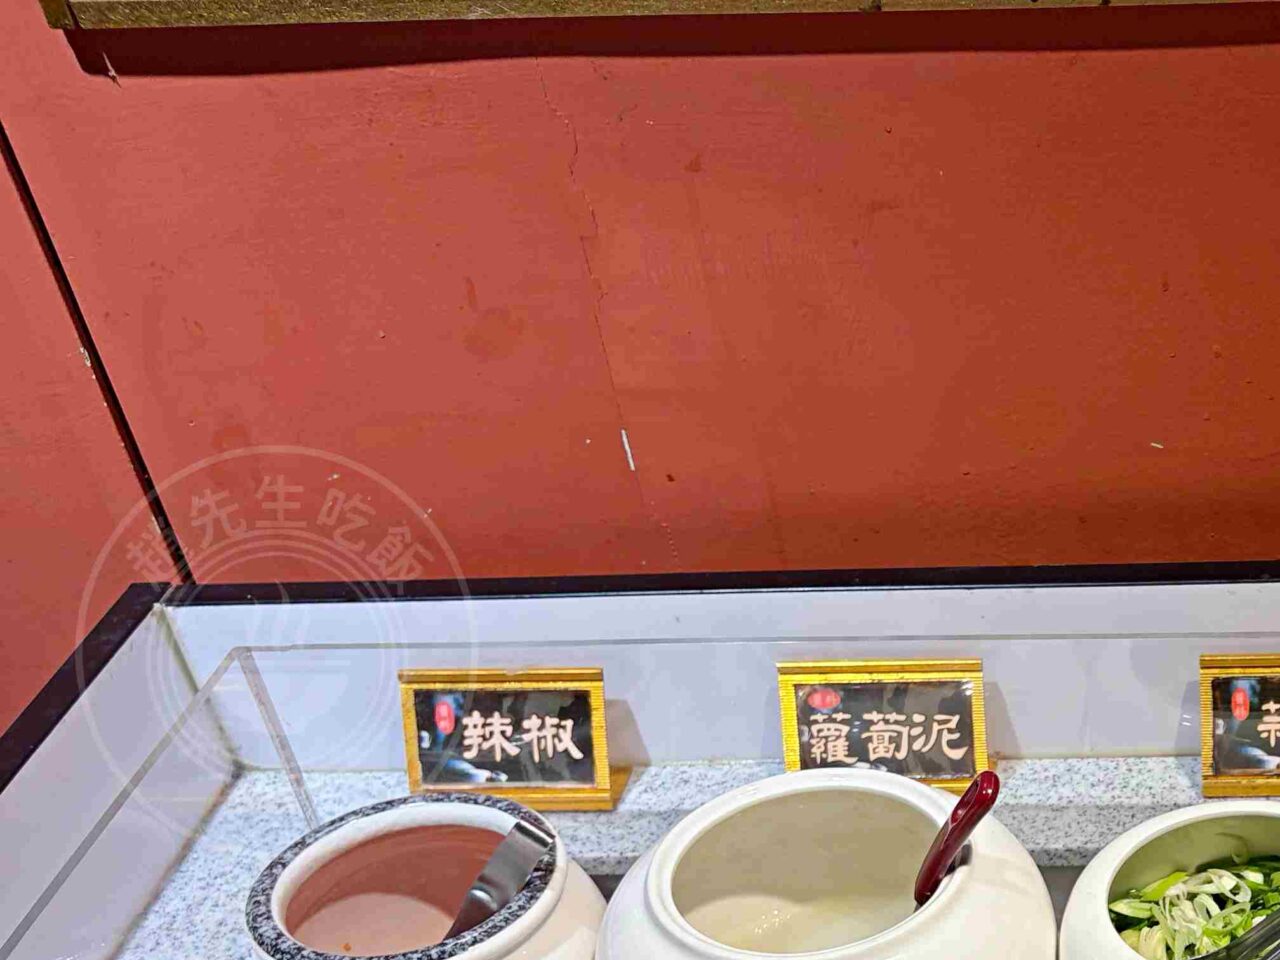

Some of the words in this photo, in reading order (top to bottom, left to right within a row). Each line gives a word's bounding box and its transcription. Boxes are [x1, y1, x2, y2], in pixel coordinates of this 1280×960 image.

[462, 710, 584, 763] 辣椒
[808, 711, 969, 765] 蘿蔔泥
